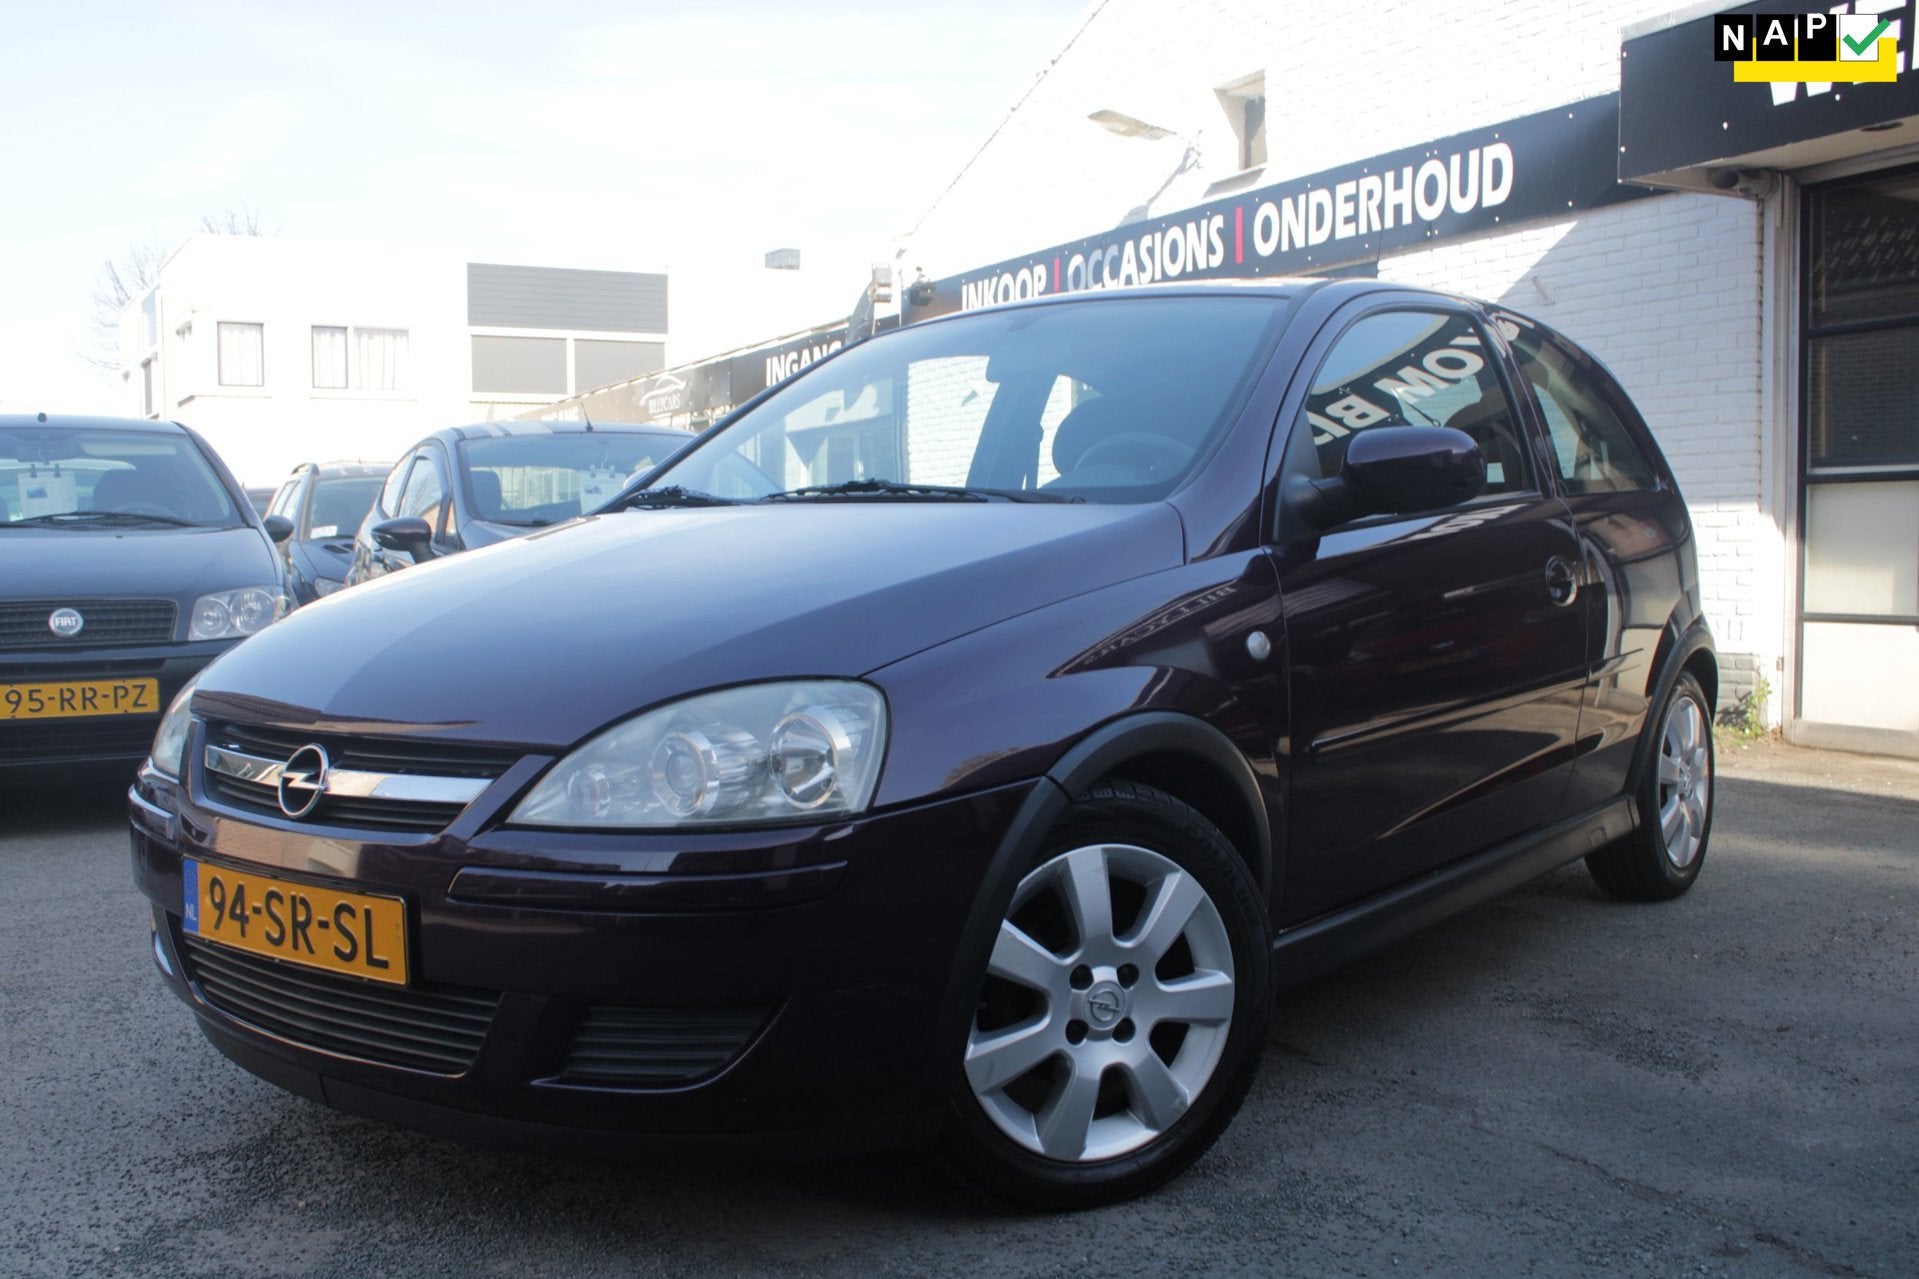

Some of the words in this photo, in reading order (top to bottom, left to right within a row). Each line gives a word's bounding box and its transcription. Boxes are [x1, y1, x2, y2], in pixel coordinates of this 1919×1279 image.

[961, 263, 1047, 312] INKOOP
[1067, 216, 1225, 293] OCCASIONS
[1253, 142, 1514, 257] ONDERHOUD
[55, 616, 77, 627] FIAT
[4, 684, 148, 713] 95-RR-PZ
[185, 903, 197, 921] NL
[209, 874, 389, 970] 94-SR-SL
